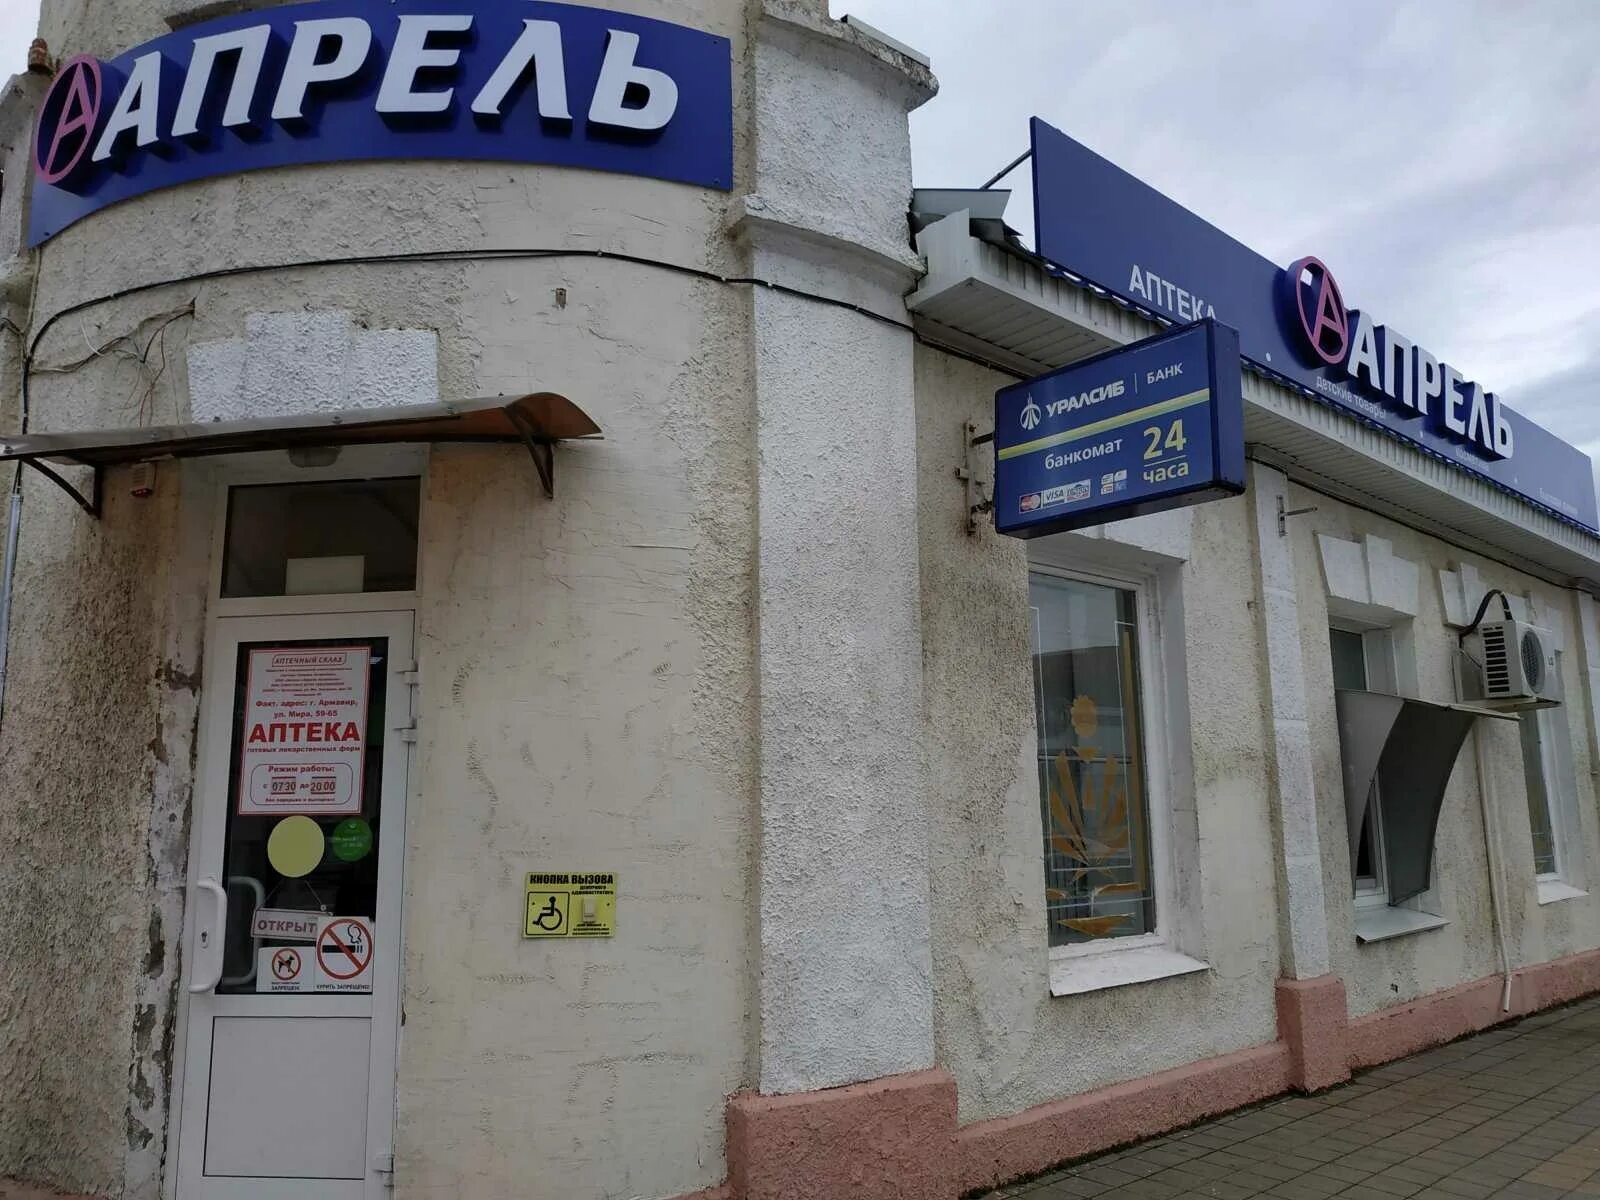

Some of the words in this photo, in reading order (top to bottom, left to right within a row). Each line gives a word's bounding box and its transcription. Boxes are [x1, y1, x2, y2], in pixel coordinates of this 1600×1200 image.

[92, 15, 679, 161] АПРЕЛЬ
[1046, 380, 1125, 418] УРАЛСИБ
[1147, 363, 1184, 384] БАНК
[1348, 311, 1514, 460] АПРЕЛЬ
[1143, 419, 1187, 460] 24
[1045, 438, 1123, 470] банкомат
[1144, 463, 1189, 483] часа
[1046, 489, 1064, 501] VISA
[249, 722, 360, 743] АПТЕКА
[530, 875, 568, 884] КНОПКА
[571, 874, 613, 884] ВЫЗОВА
[258, 920, 318, 933] ОТКРЫТ
